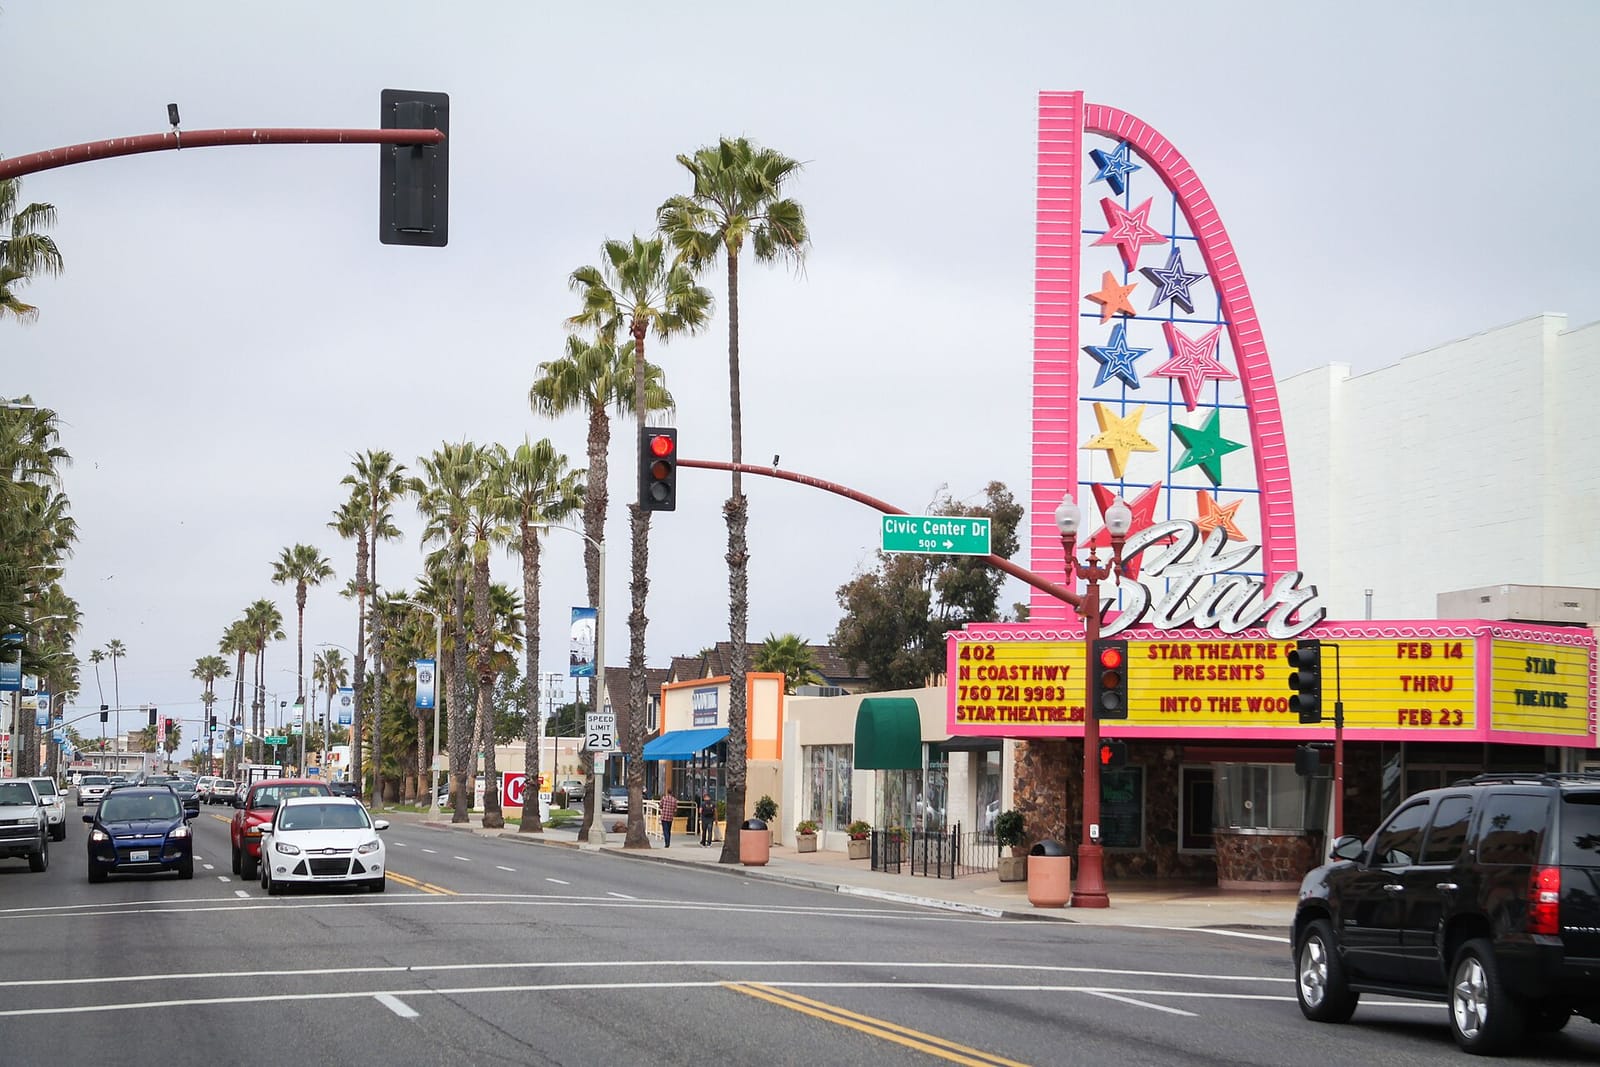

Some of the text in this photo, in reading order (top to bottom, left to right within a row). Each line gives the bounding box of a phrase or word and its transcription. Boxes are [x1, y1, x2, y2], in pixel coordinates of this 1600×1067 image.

[885, 519, 987, 537] Civic Center Dr
[918, 539, 937, 548] 500
[1084, 518, 1327, 640] Star
[960, 645, 995, 660] 402
[1148, 643, 1192, 660] STAR
[1197, 643, 1277, 659] THEATRE
[1397, 642, 1463, 659] FEB 14
[959, 665, 970, 680] N
[1173, 664, 1265, 681] PRESENTS
[1525, 656, 1556, 675] STAR
[1400, 675, 1454, 692] THRU
[959, 685, 1065, 702] 760 721 9983
[1514, 688, 1568, 708] THEATRE
[1160, 696, 1289, 712] INTO THE WOO
[1397, 709, 1463, 726] FEB 23
[588, 733, 612, 747] 25
